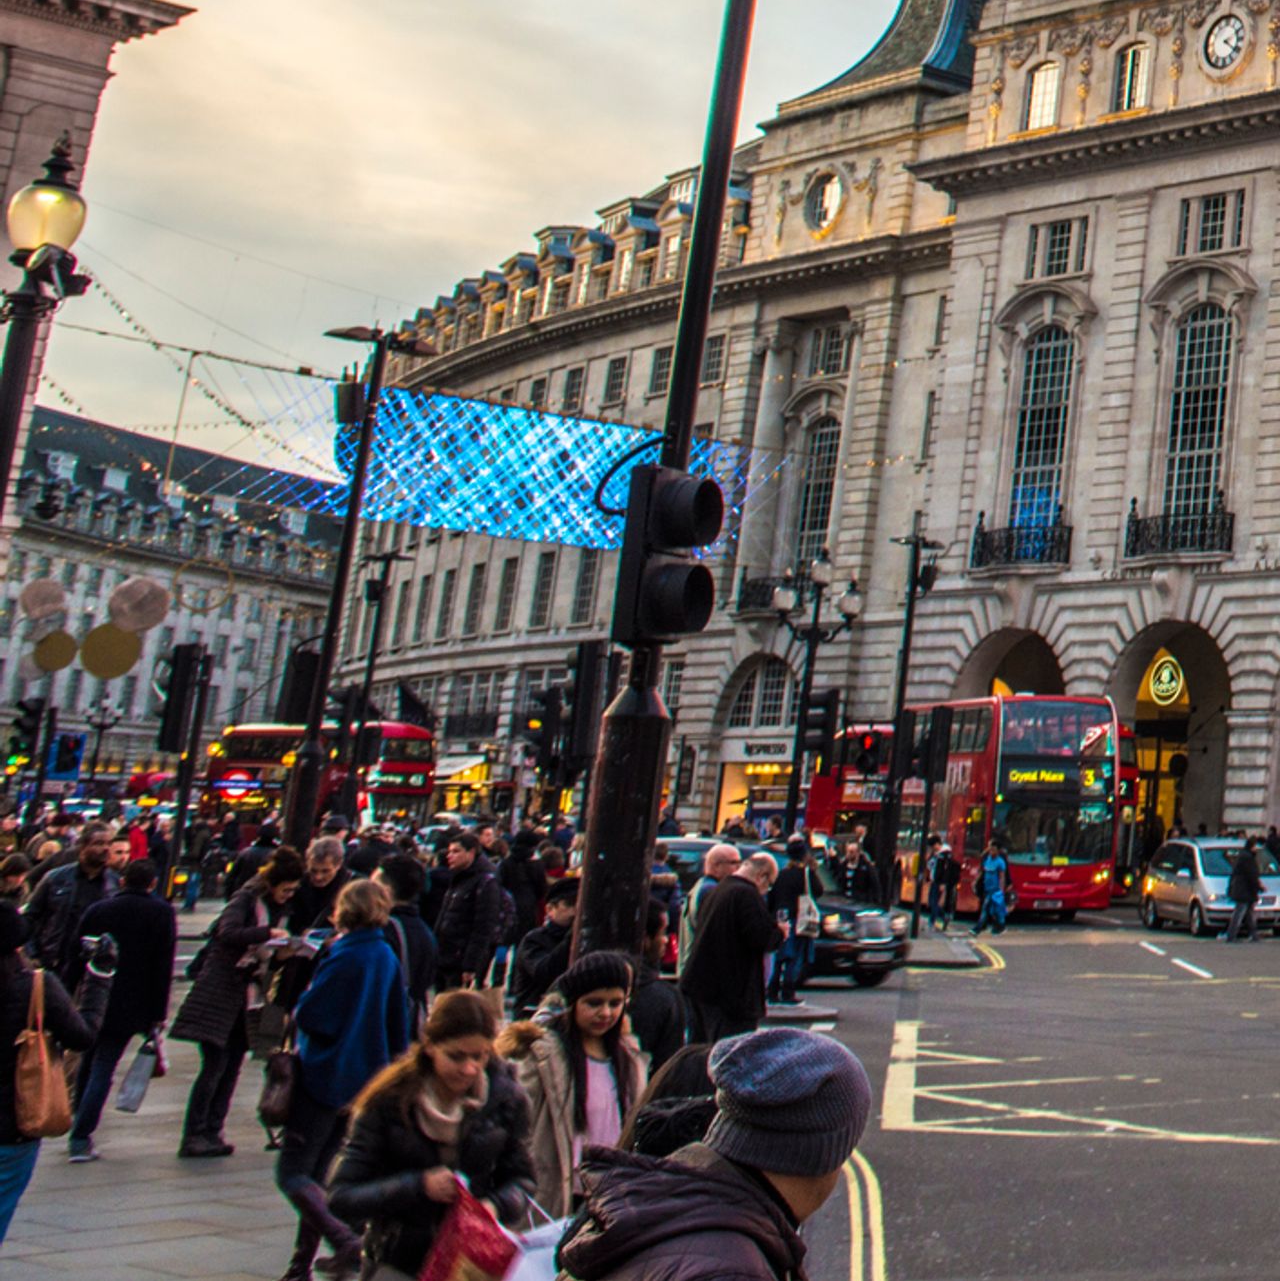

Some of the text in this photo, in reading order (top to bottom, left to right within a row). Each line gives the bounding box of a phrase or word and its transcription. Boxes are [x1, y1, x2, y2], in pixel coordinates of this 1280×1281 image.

[1009, 768, 1095, 787] Crystal Palace 3
